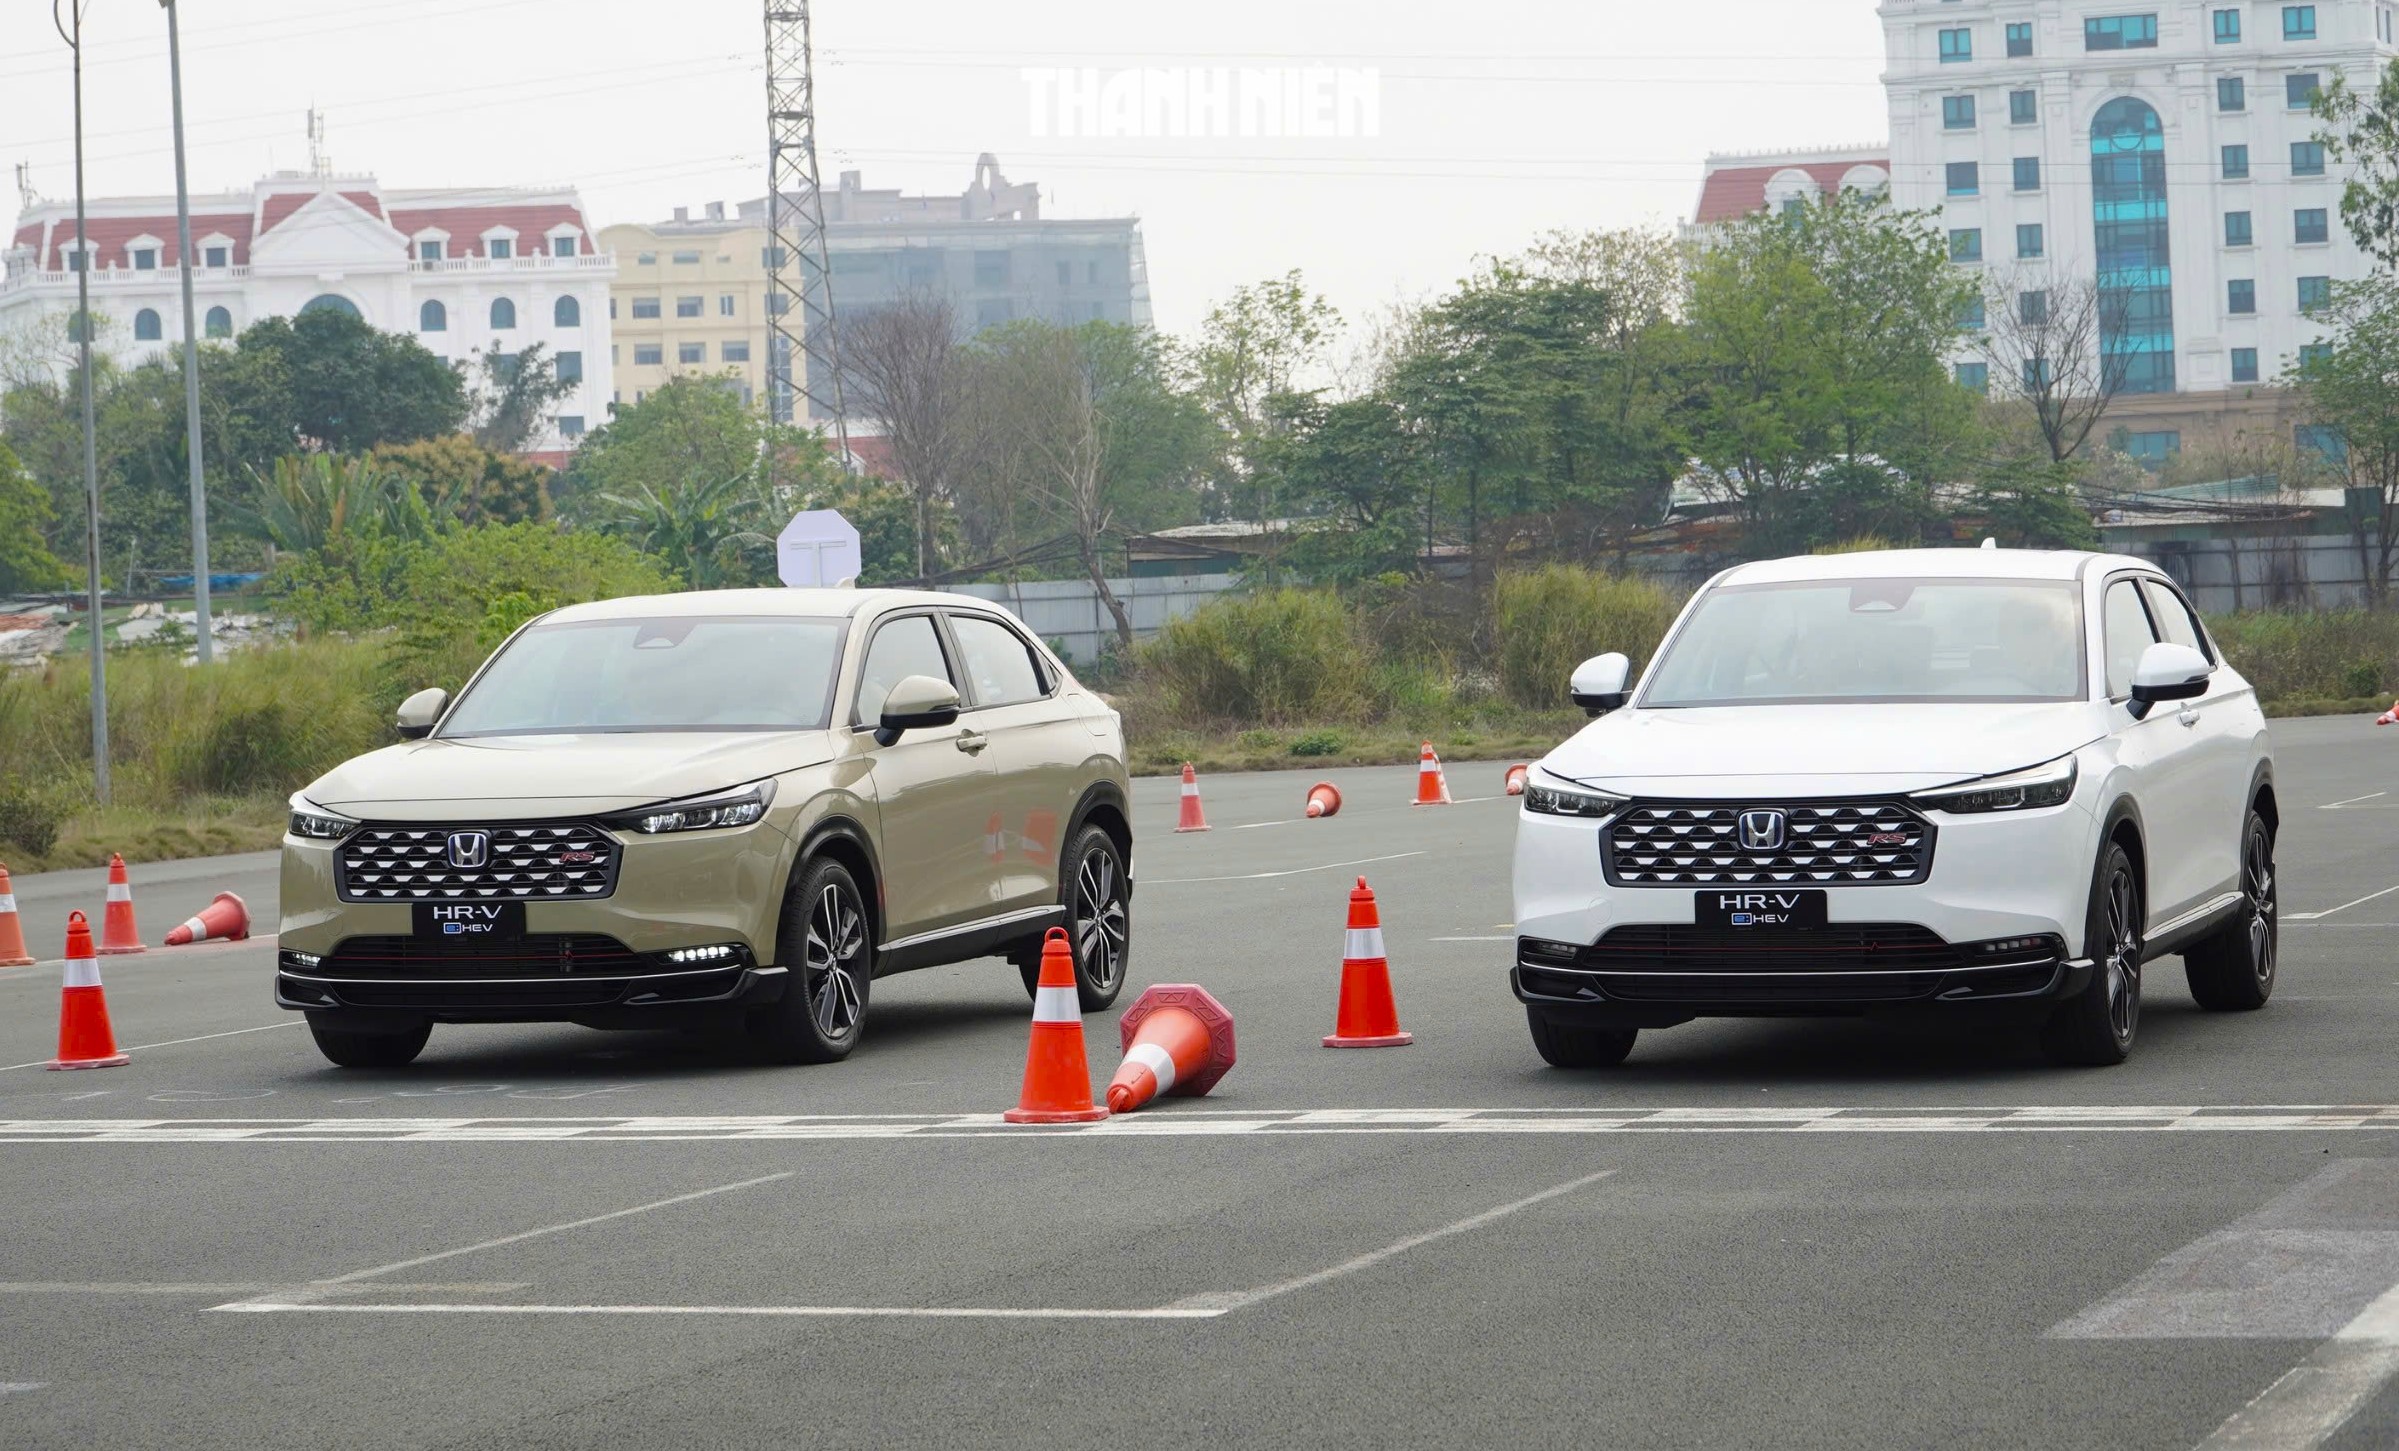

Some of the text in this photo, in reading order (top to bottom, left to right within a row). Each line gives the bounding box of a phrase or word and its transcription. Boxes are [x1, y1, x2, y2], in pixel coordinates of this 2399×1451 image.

[1867, 833, 1907, 845] RS
[560, 852, 595, 862] RS
[1719, 894, 1799, 910] HR-V
[433, 905, 502, 919] HR-V
